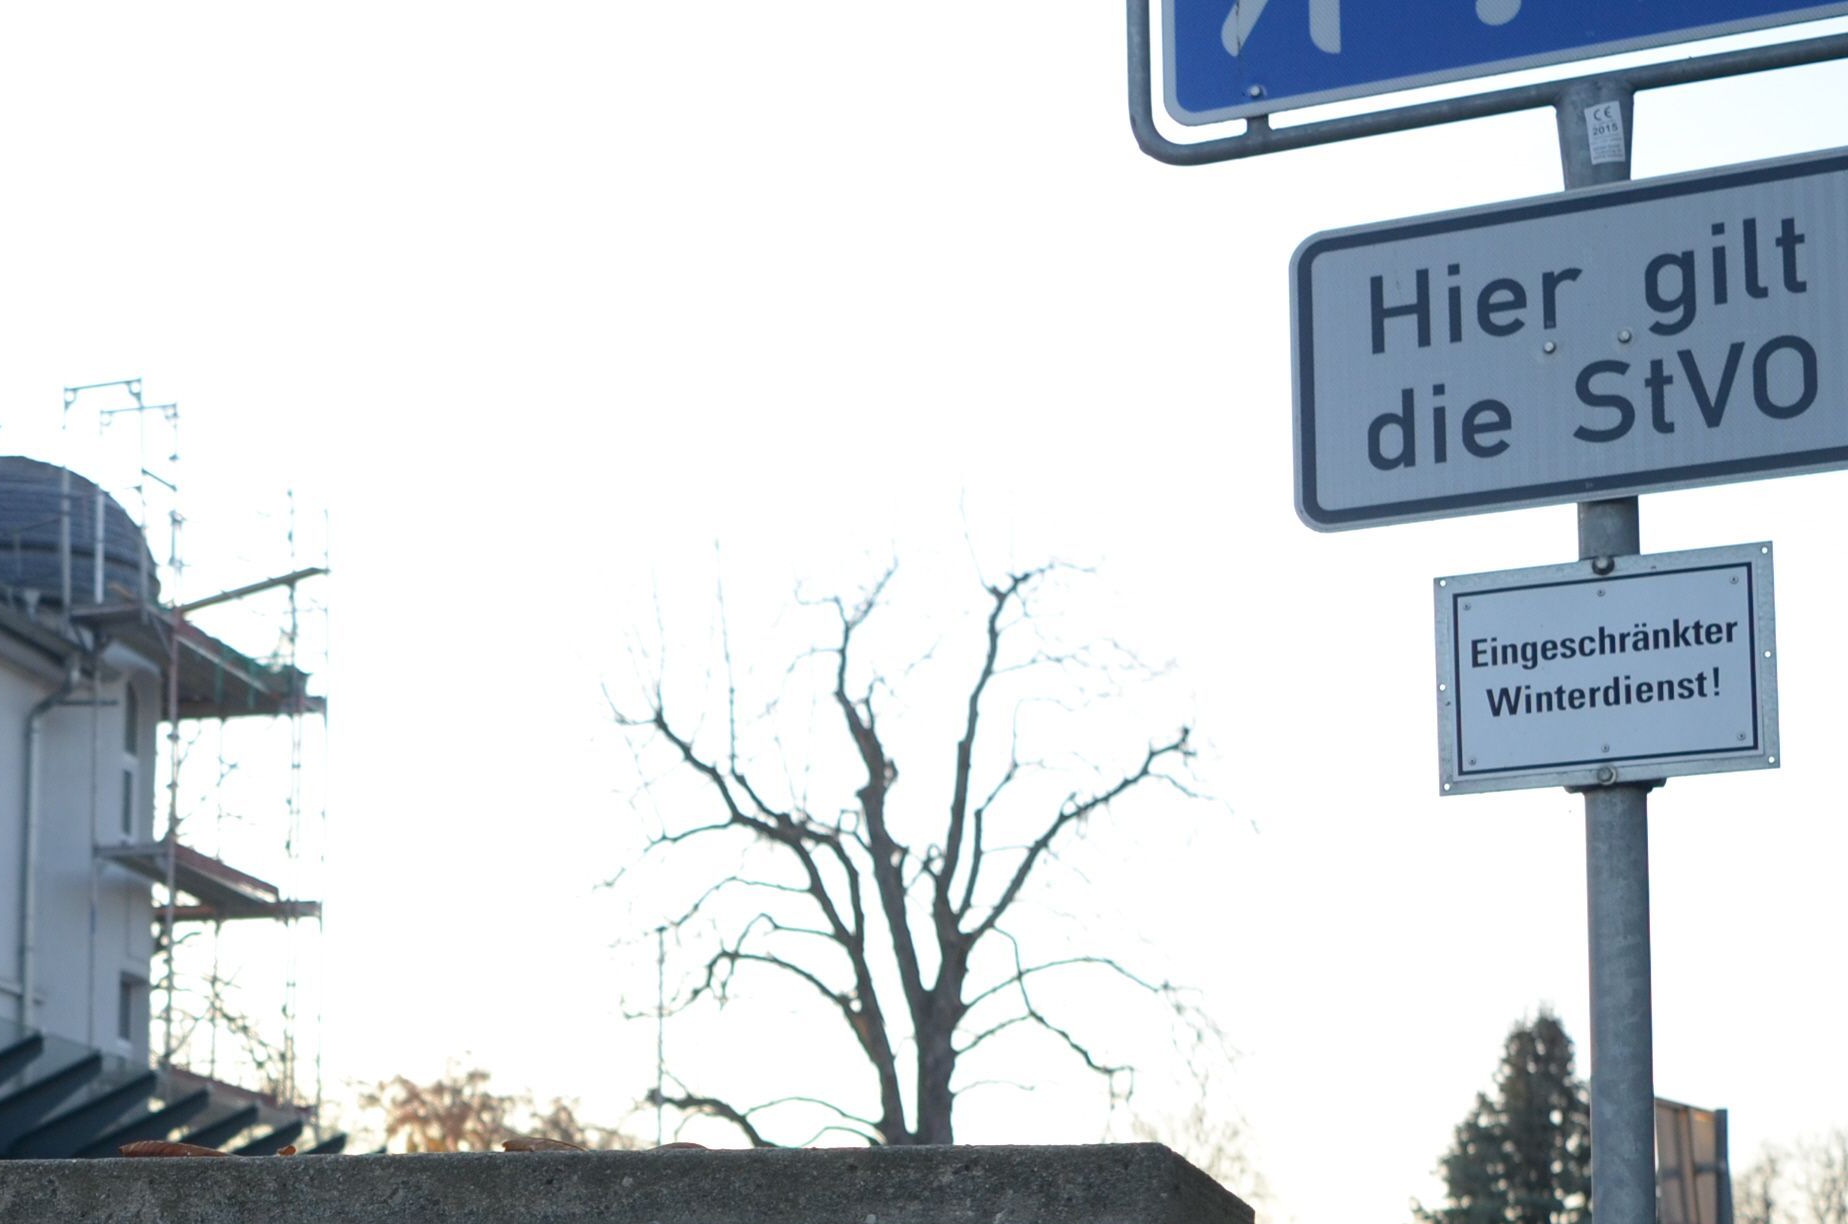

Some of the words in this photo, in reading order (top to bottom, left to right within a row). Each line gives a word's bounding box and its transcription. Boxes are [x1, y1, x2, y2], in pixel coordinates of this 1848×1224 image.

[1369, 263, 1583, 355] Hier
[1644, 216, 1809, 337] gilt
[1367, 383, 1512, 471] die
[1572, 334, 1819, 444] StVO
[1471, 617, 1739, 670] Eingeschränkter
[1485, 666, 1721, 717] Winterdienst!
